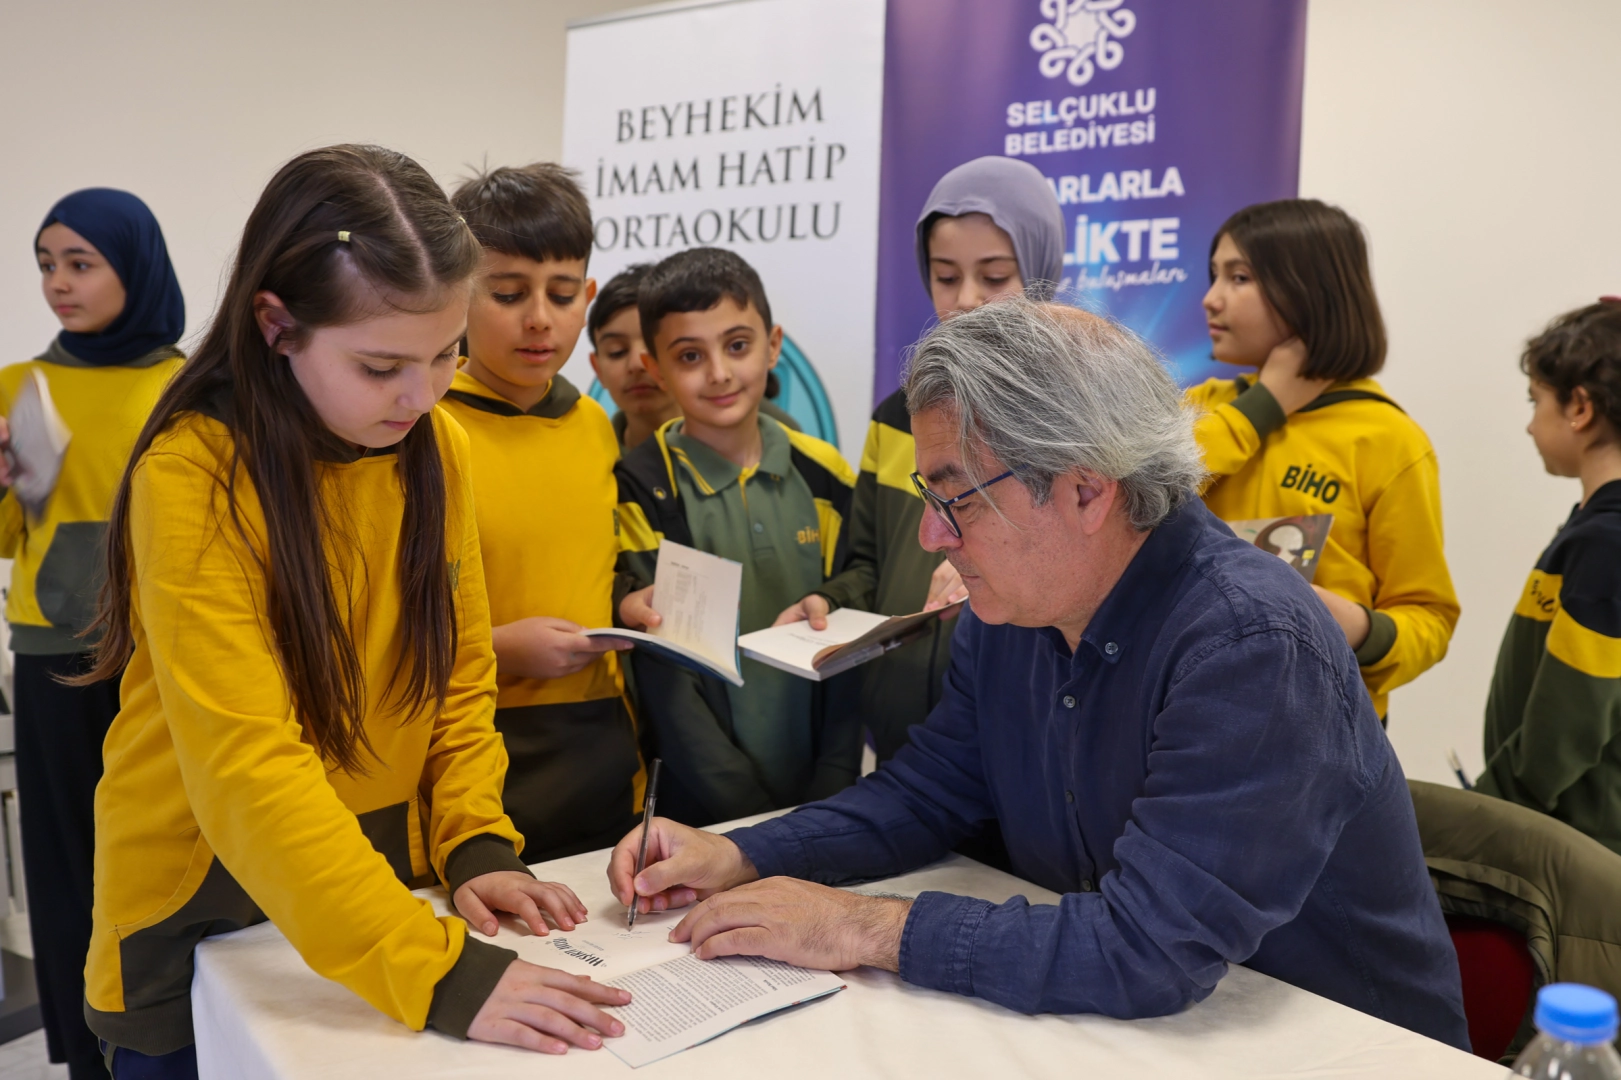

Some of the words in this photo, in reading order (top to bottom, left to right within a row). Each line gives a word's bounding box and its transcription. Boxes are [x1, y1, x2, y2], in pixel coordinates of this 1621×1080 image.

[616, 82, 825, 144] BEYHEKİM
[1006, 87, 1157, 128] SELÇUKLU
[1004, 114, 1156, 156] BELEDİYESİ
[595, 157, 702, 199] İMAM
[717, 136, 846, 188] HATİP
[593, 201, 841, 252] ORTAOKULU
[1280, 463, 1341, 504] BİHO
